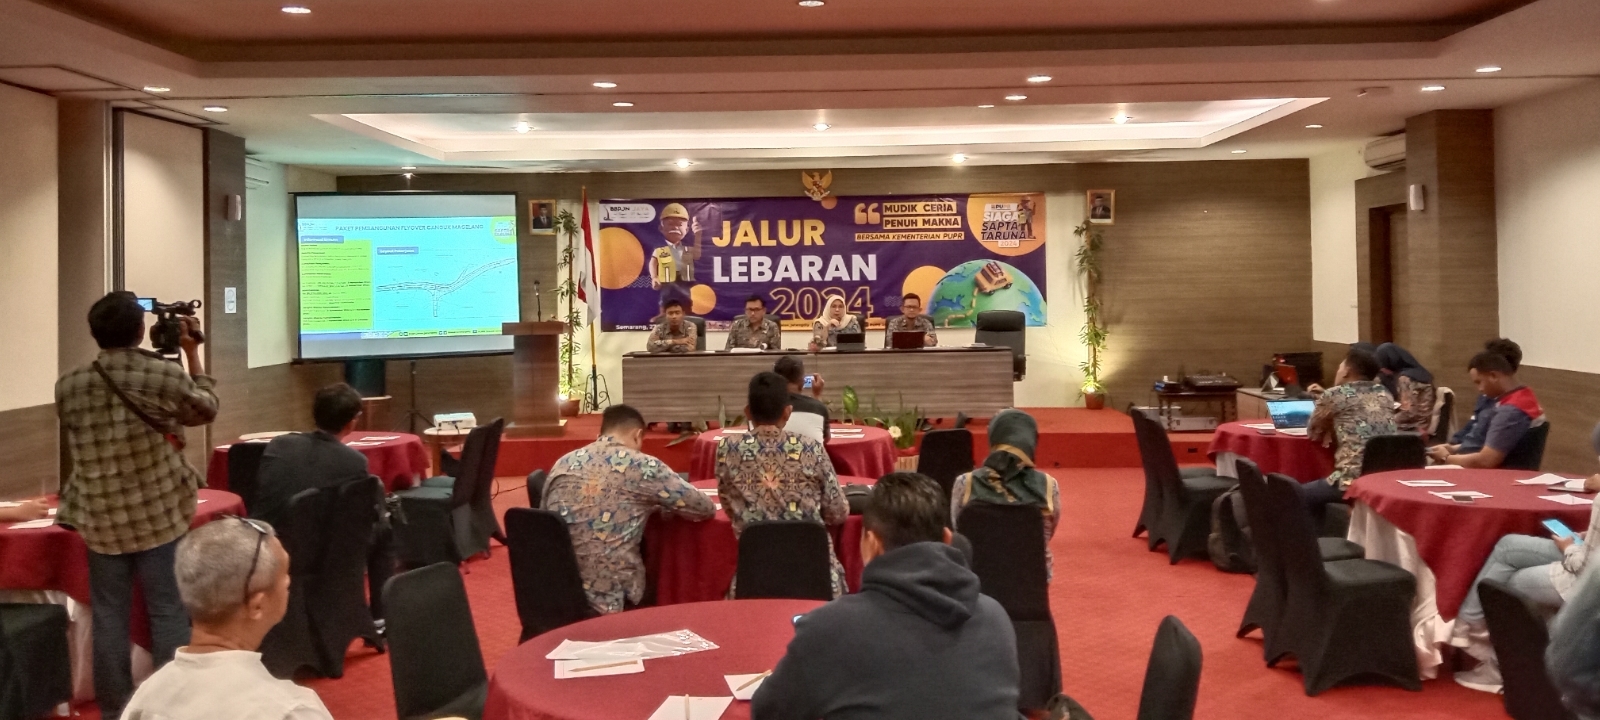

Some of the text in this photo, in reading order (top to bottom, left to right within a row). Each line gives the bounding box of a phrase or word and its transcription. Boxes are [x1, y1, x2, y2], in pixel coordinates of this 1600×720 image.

[884, 203, 954, 213] MUDIK CERIA
[983, 211, 1020, 221] SIAGA
[884, 218, 959, 227] PENUH MAKNA
[981, 222, 1018, 231] SAPTA
[711, 219, 826, 247] JALUR
[943, 232, 963, 240] PUPR
[981, 231, 1027, 240] TARUNA
[713, 254, 877, 282] LEBARAN
